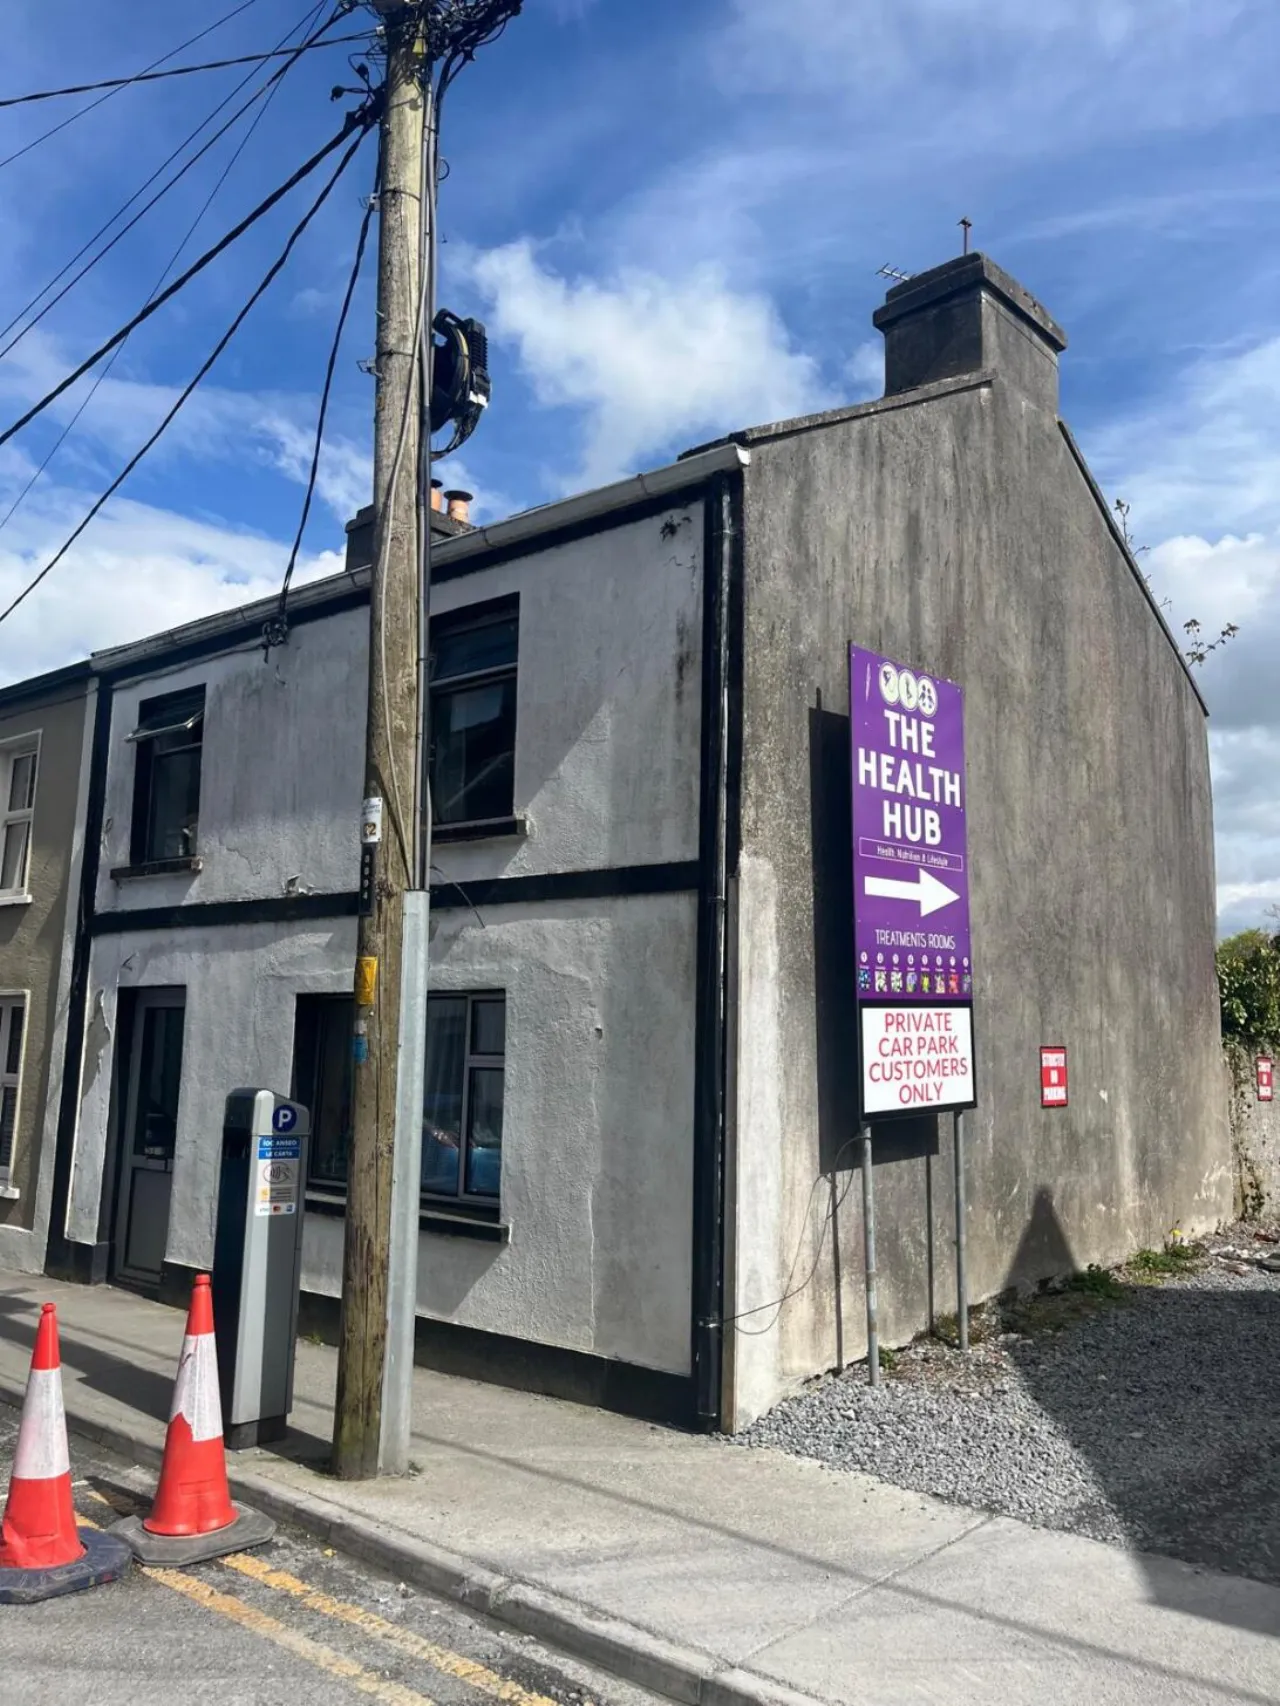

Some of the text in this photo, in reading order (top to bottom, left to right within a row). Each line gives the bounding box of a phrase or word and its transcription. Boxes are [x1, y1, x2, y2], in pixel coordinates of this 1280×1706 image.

[884, 709, 936, 758] THE
[858, 747, 961, 807] HEALTH
[883, 800, 942, 846] HUB
[875, 929, 956, 950] TREATMENTS ROOMS
[884, 1012, 953, 1033] PRIVATE
[878, 1035, 959, 1057] CAR PARK
[869, 1057, 968, 1082] CUSTOMERS
[899, 1082, 944, 1105] ONLY
[278, 1109, 292, 1128] P
